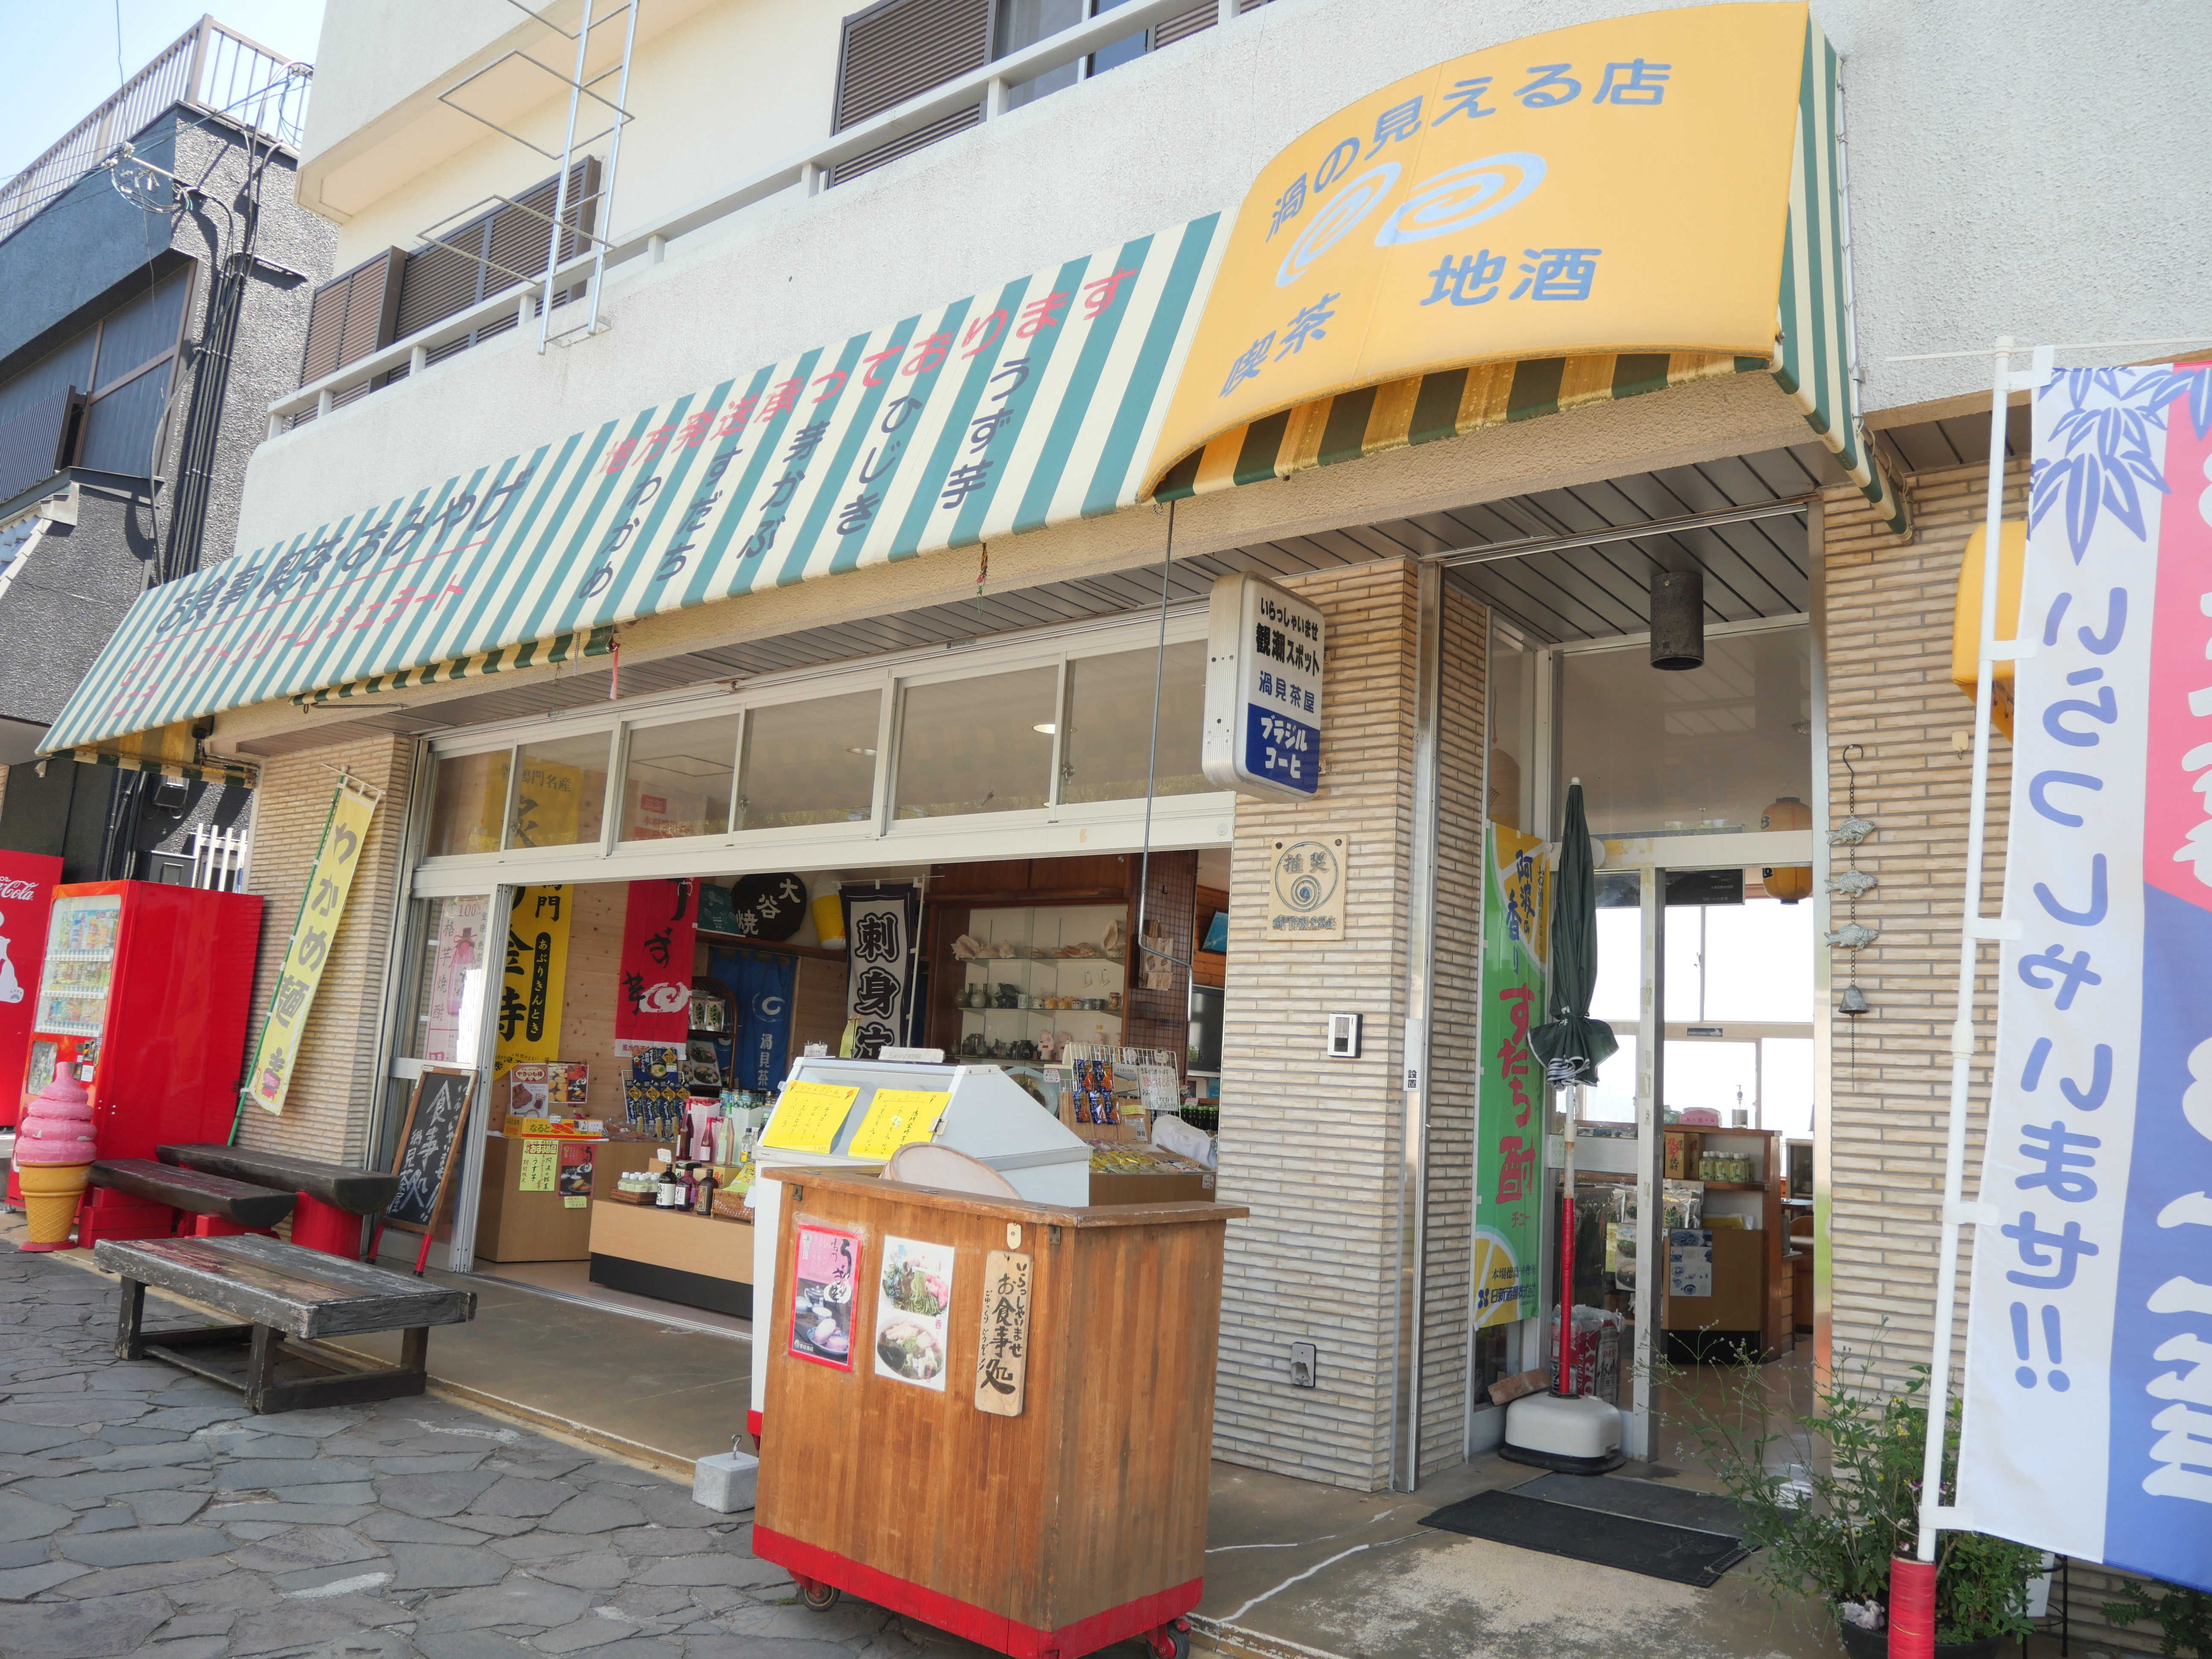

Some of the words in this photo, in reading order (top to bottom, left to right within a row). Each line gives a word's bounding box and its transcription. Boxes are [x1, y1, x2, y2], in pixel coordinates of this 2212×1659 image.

[1266, 58, 1672, 242] 渦の見える店
[1420, 247, 1603, 306] 地酒
[596, 267, 1138, 476] 地方発送承っております
[1218, 292, 1341, 399] 喫茶
[836, 396, 923, 535] ひじき
[941, 357, 1030, 509] うず芋
[656, 447, 743, 582] すだち
[736, 421, 830, 559] 芽かぶ
[579, 476, 662, 598] わかめ
[1255, 623, 1319, 677] 観潮スポット
[1260, 597, 1318, 642] いらっしゃいませ
[1258, 670, 1315, 714] 渦見茶屋
[1260, 715, 1307, 752] ブラジル
[530, 939, 547, 1034] あぶりきんとき
[758, 1033, 773, 1093] 渦見茶
[800, 1085, 839, 1095] ソフトクリーム
[1408, 1070, 1417, 1088] 設置
[530, 1124, 551, 1133] なると
[530, 1144, 556, 1154] おすすめ品
[981, 1273, 1016, 1394] お食事処
[983, 1290, 993, 1324] ごゆっくり
[1009, 1262, 1027, 1358] いらっしゃいませ
